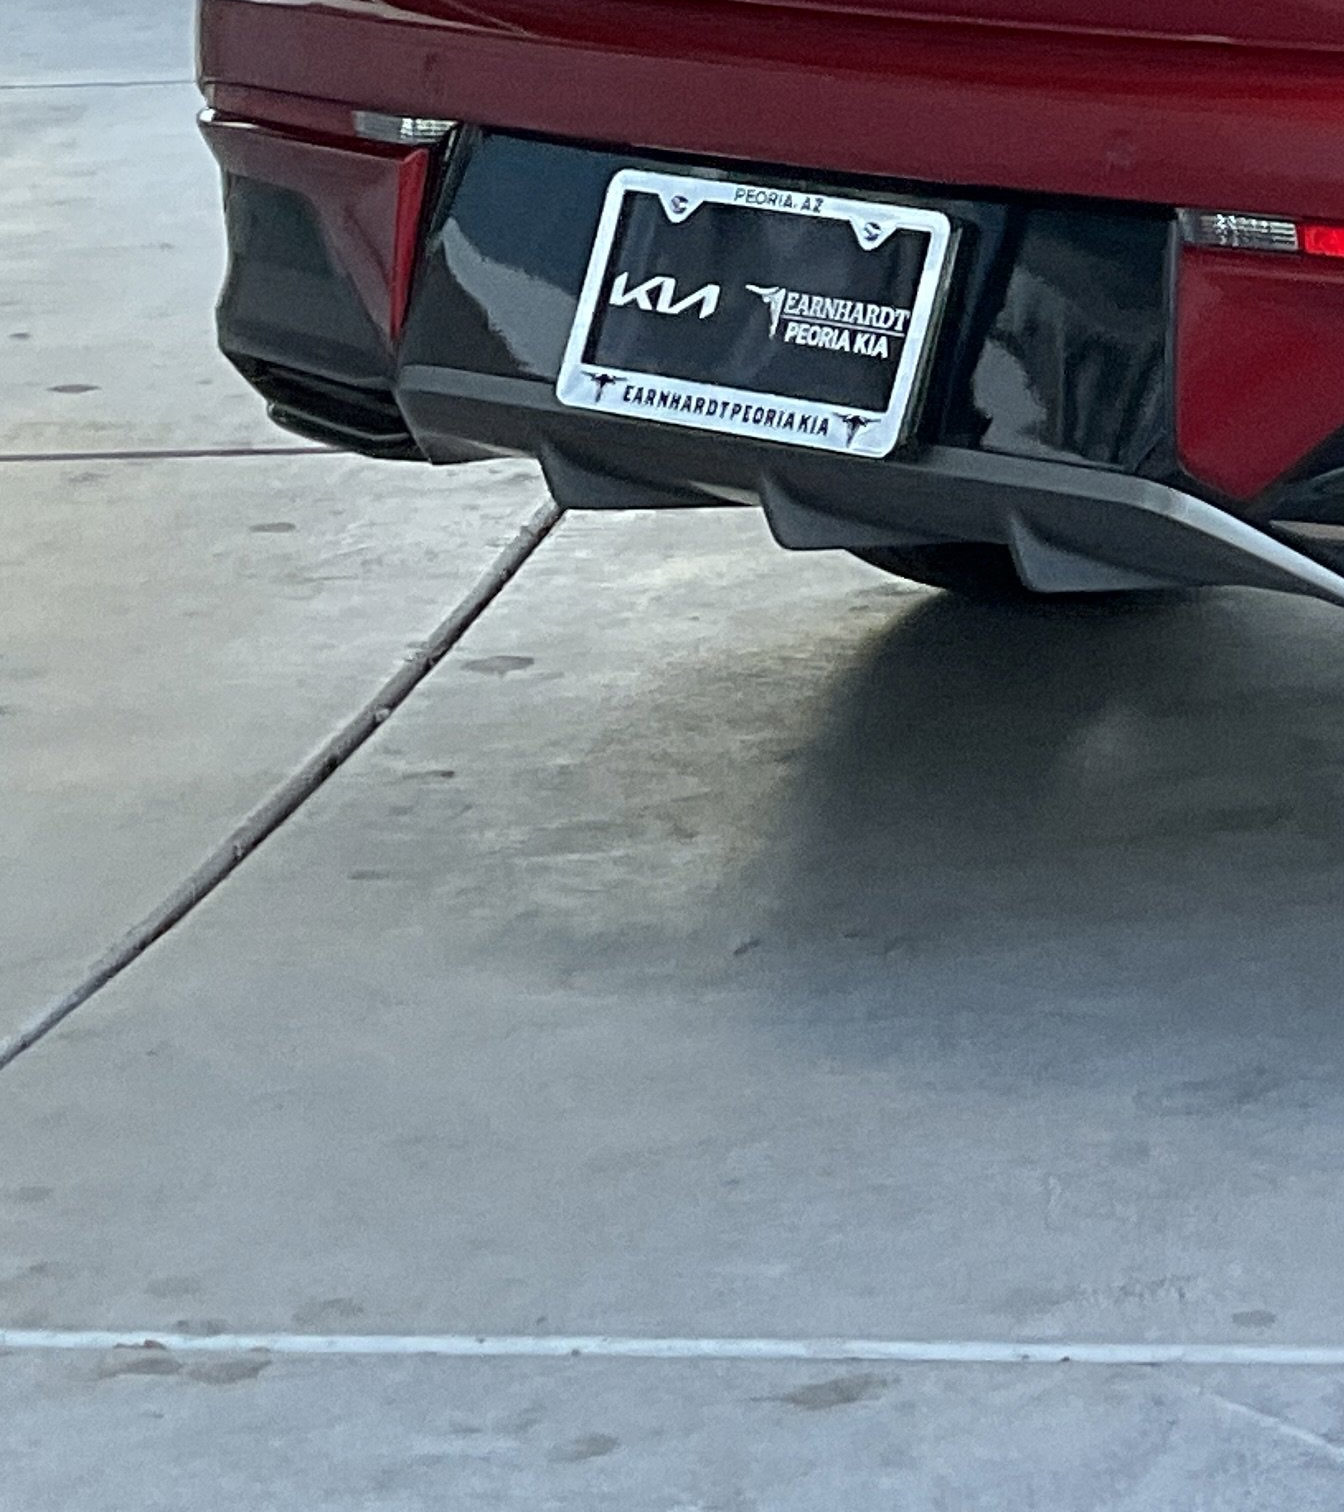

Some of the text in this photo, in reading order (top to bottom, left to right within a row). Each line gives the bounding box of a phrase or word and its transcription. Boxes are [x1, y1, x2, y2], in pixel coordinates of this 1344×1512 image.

[800, 196, 824, 213] AZ
[610, 271, 720, 318] KIA
[783, 291, 911, 331] EARNHARDT
[784, 321, 888, 359] PEORIA KIA
